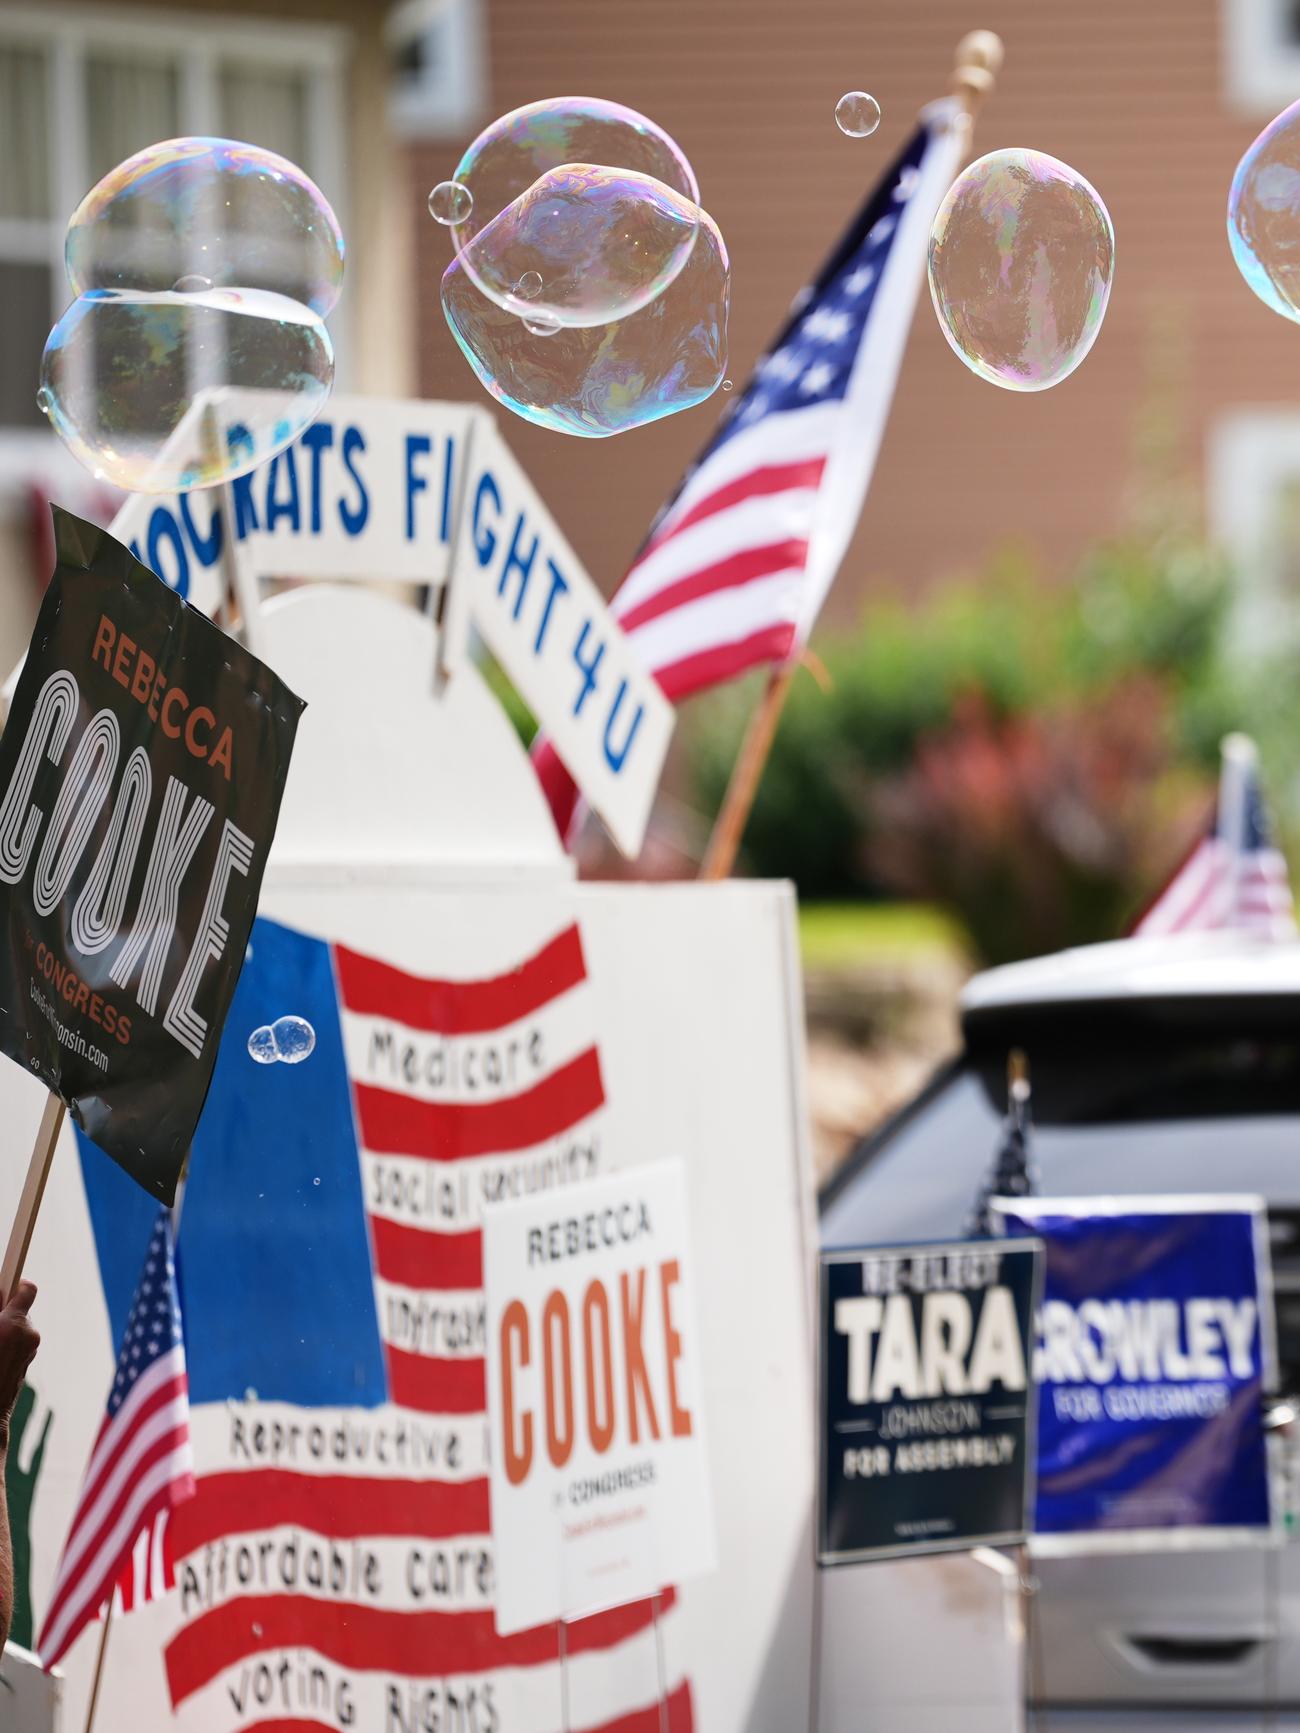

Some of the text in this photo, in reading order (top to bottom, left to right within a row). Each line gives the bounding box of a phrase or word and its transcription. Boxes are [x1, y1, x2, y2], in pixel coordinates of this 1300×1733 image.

[405, 434, 569, 656] FIGHT
[573, 620, 606, 716] 4
[601, 681, 645, 774] U
[91, 614, 233, 781] REBECCA
[0, 669, 255, 1060] COOKE
[36, 942, 133, 1046] CONGRESS
[368, 1027, 546, 1090] Medicare
[528, 1200, 655, 1266] REBECCA
[500, 1258, 693, 1487] COOKE
[834, 1286, 1029, 1404] TARA
[228, 1415, 463, 1470] Reproductive
[879, 1401, 980, 1439] JOHNSON
[1055, 1384, 1101, 1421] FOR
[843, 1434, 1015, 1479] FOR ASSEMBLY
[181, 1530, 495, 1612] Affordable care
